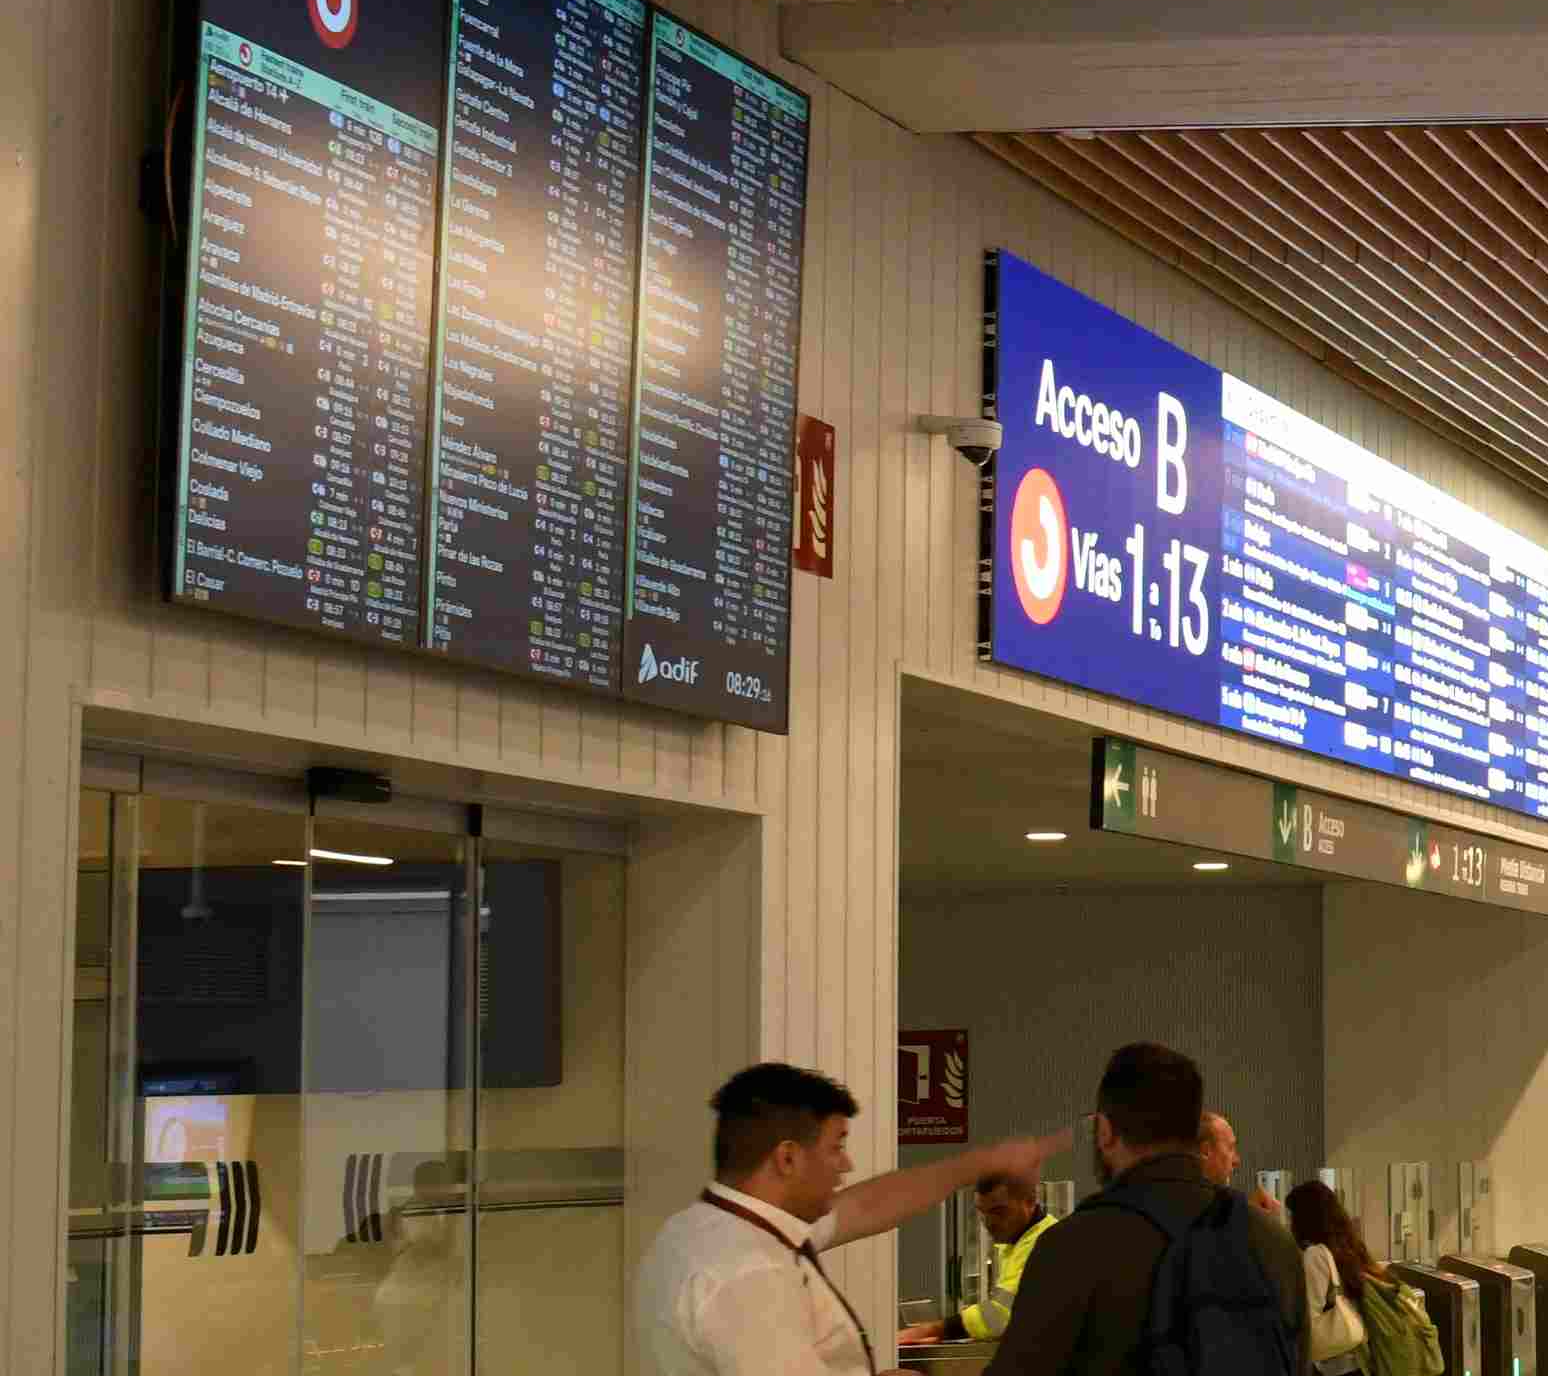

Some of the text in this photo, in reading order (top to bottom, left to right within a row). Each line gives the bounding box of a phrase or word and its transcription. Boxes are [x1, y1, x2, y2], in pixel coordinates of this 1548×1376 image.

[1034, 358, 1142, 469] Acceso
[1155, 391, 1188, 515] B
[1071, 526, 1122, 602] Vías
[1126, 523, 1144, 636] 1
[1163, 539, 1209, 656] 13
[659, 651, 700, 686] adif
[725, 670, 761, 701] 08:29
[1302, 803, 1313, 852] B
